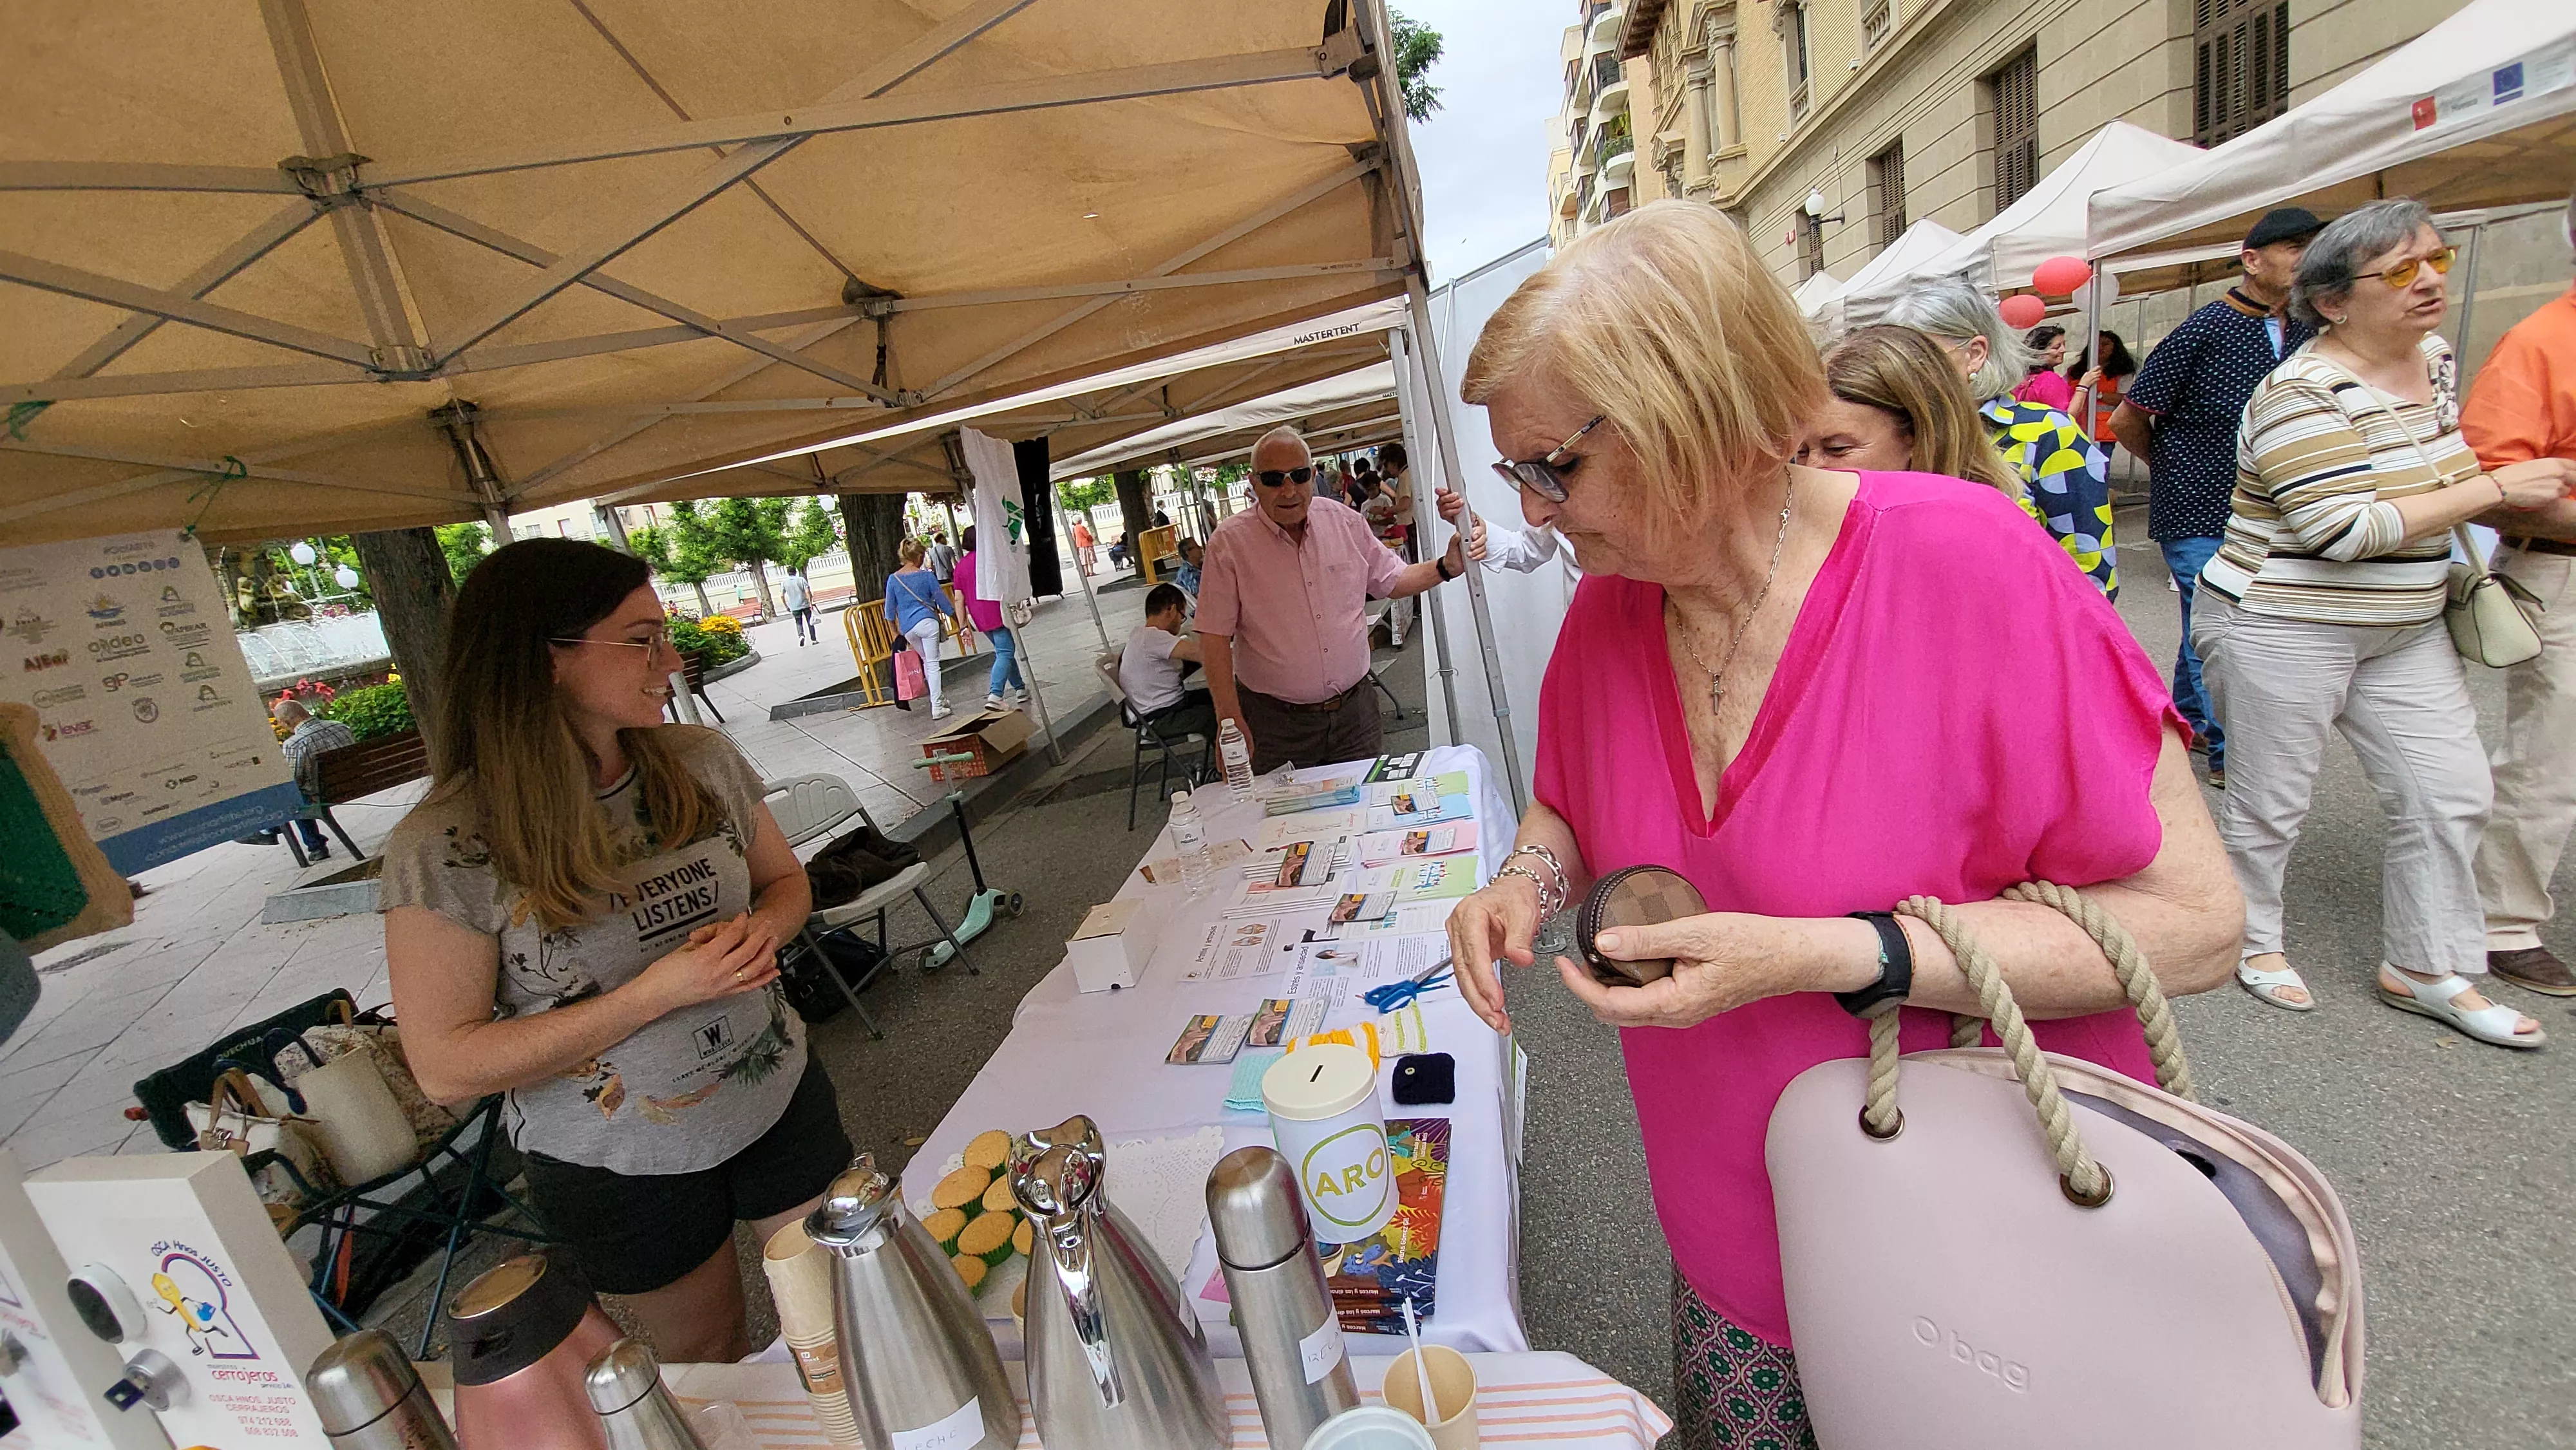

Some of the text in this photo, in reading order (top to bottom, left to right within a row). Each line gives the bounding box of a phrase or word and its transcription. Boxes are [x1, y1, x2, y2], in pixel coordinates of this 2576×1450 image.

[1294, 323, 1360, 345] MASTERTENT
[1287, 976, 1300, 995] Estrés
[703, 1024, 721, 1047] W
[216, 1036, 263, 1062] QUECHUA
[1315, 1147, 1385, 1197] ARO
[1913, 1315, 2029, 1395] O bag
[212, 1366, 278, 1385] cerrajeros
[209, 1394, 234, 1402] OSCA
[267, 1396, 296, 1405] JUSTO
[225, 1404, 290, 1413] CERRAJEROS
